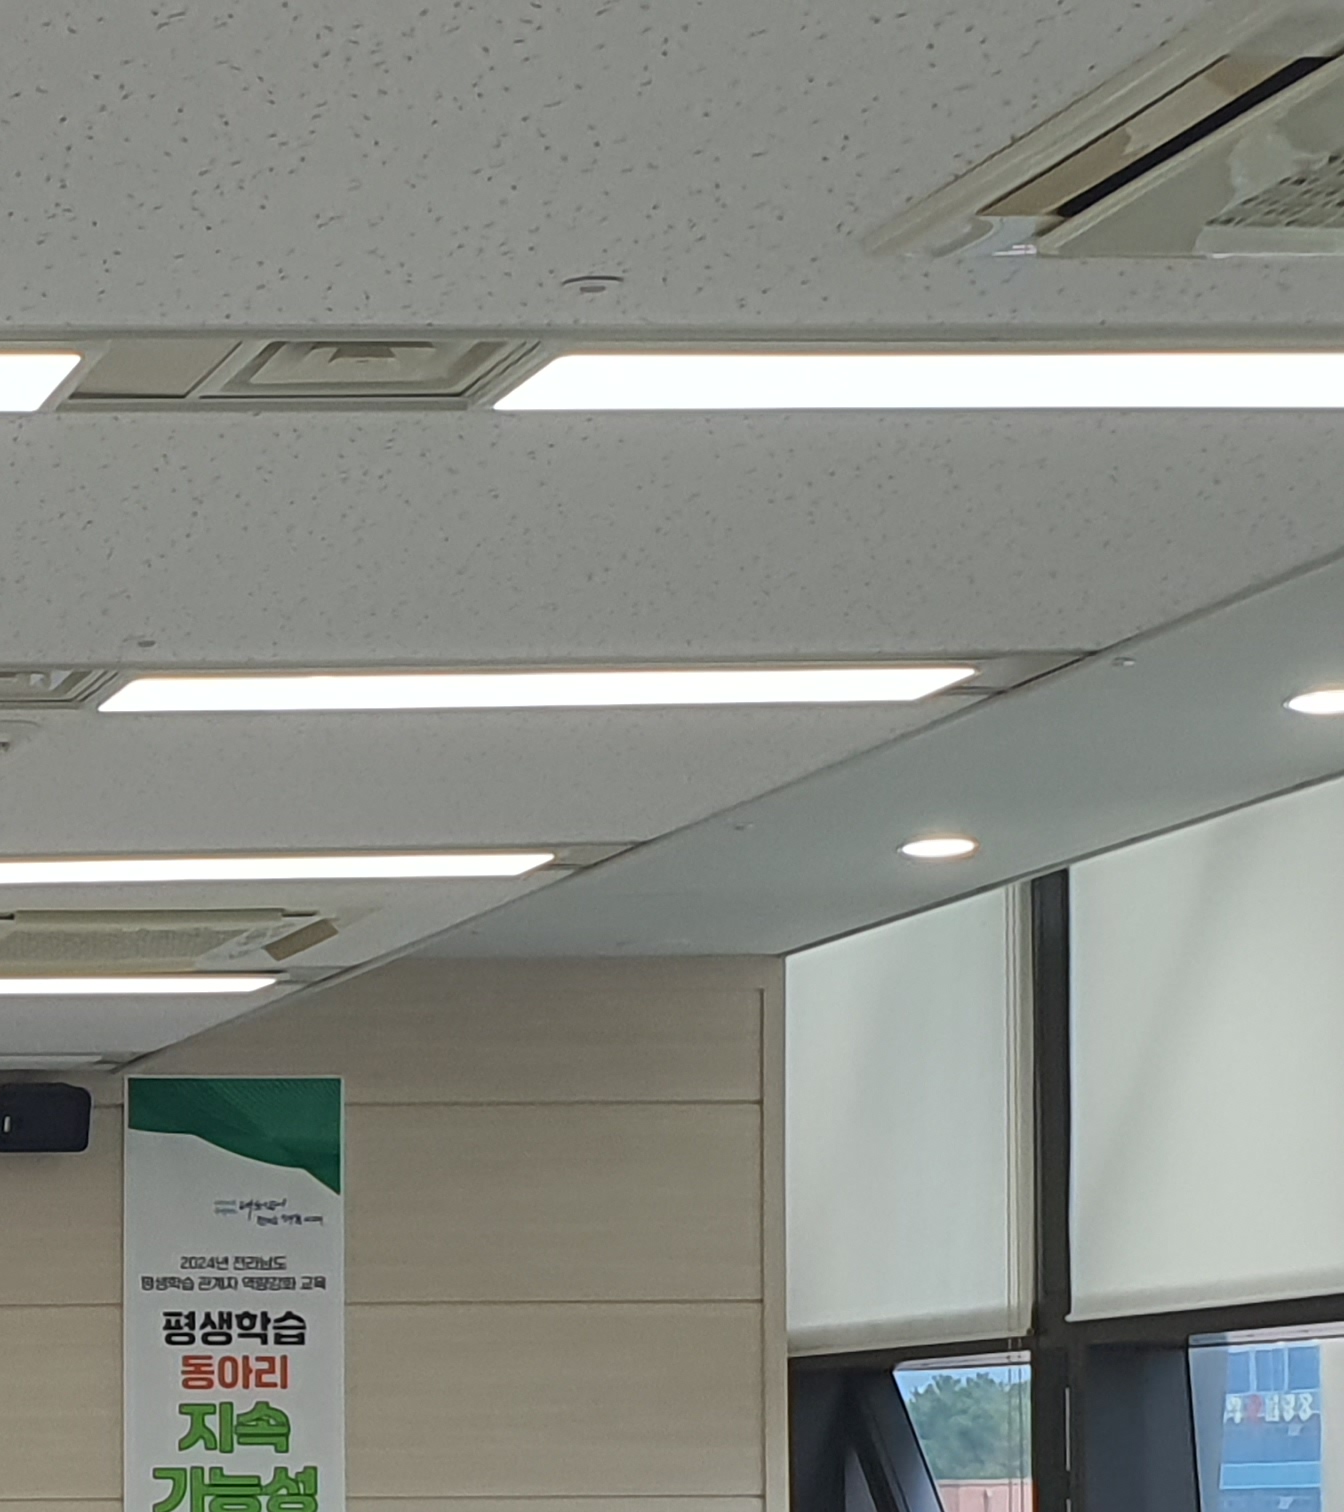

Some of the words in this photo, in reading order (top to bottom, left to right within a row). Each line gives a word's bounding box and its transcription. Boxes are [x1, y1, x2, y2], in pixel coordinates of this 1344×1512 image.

[162, 1310, 307, 1346] 평생학습
[181, 1354, 289, 1390] 동아리
[178, 1401, 291, 1454] 지속
